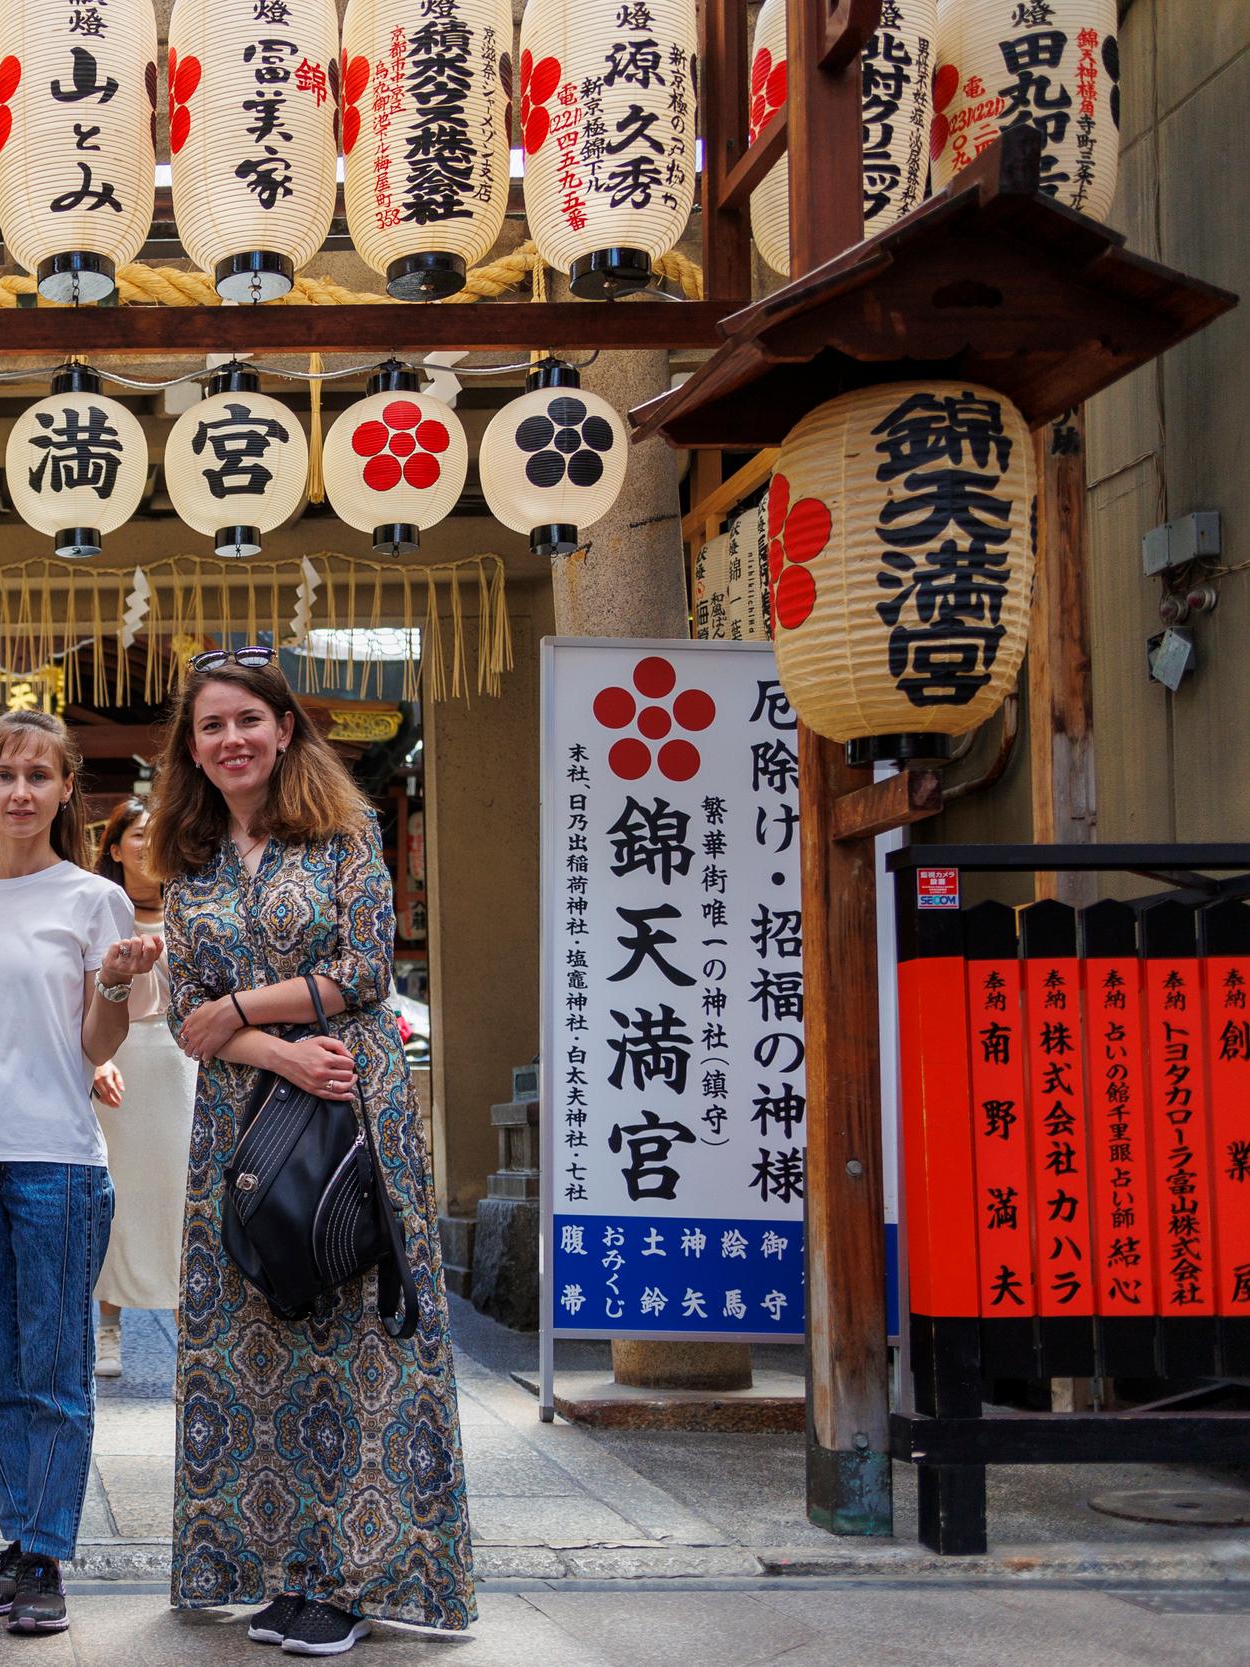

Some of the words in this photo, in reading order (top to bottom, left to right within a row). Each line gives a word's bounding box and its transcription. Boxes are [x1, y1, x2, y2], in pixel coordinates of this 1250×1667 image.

[68, 0, 110, 39] 燈
[293, 56, 328, 109] 錦
[388, 24, 410, 116] 京都市中京区
[49, 45, 124, 214] 山とみ
[401, 19, 478, 226] 積水ハウス株式会社
[579, 75, 607, 195] 新京極錦下ル
[604, 37, 666, 211] 源久秀
[27, 405, 124, 500] 満
[190, 402, 290, 500] 宮
[870, 390, 1013, 707] 錦天満宮
[747, 679, 806, 1204] 厄除け・招福の神様
[920, 895, 956, 905] SECOM
[605, 795, 697, 1203] 錦天満宮
[983, 970, 1008, 1013] 奉納
[1042, 968, 1068, 1011] 奉納
[1101, 968, 1127, 1012] 奉納
[1161, 969, 1188, 1013] 奉納
[1221, 966, 1247, 1011] 奉納
[1162, 1020, 1206, 1307] トヨタカローラ富山株式会社
[559, 1224, 588, 1316] 腹帯
[601, 1226, 626, 1319] おみくじ
[639, 1226, 669, 1318] 土鈴
[680, 1227, 709, 1319] 神矢
[719, 1228, 750, 1320] 絵馬
[759, 1229, 789, 1321] 御守
